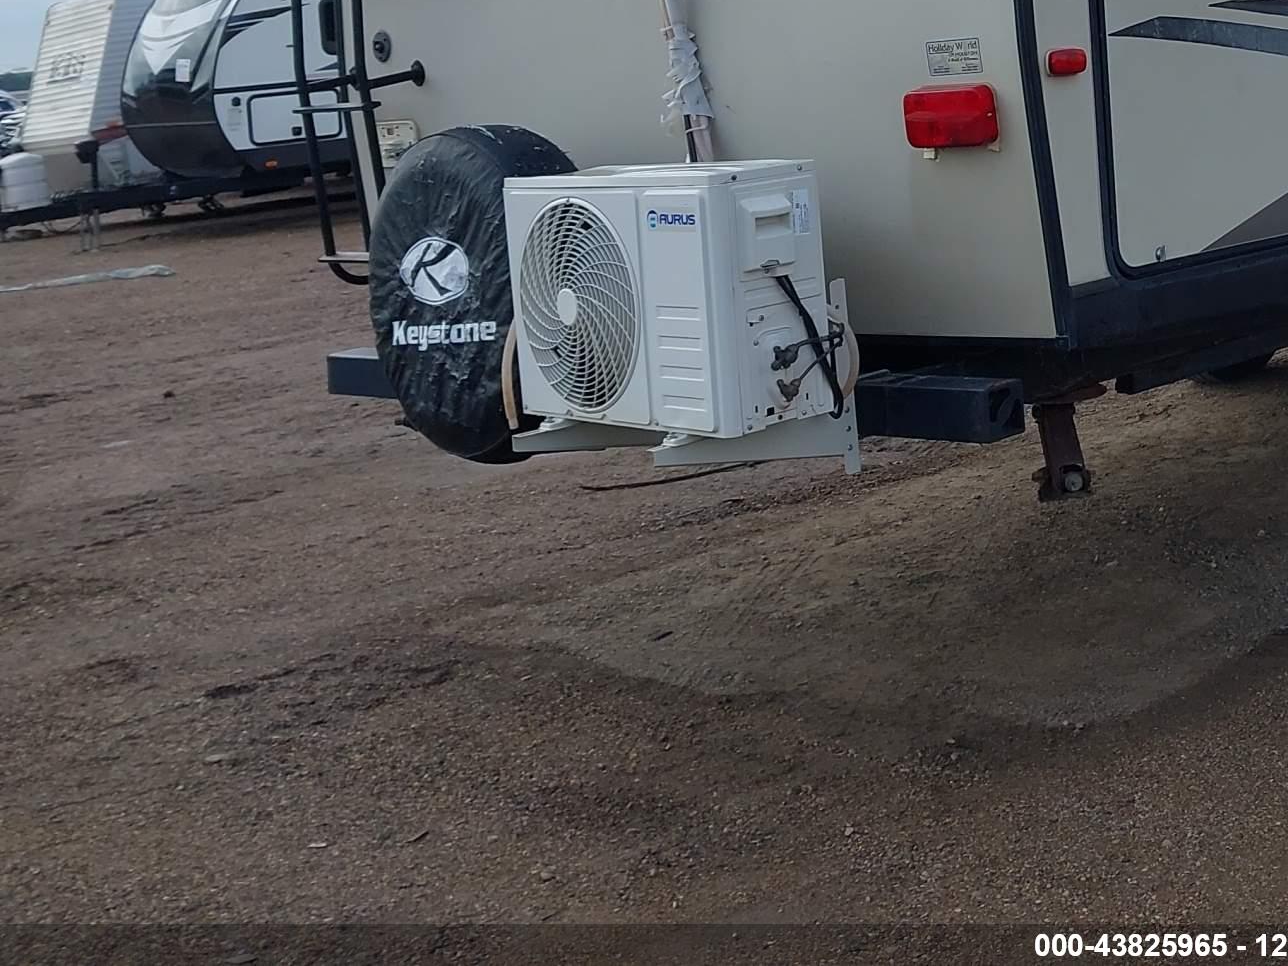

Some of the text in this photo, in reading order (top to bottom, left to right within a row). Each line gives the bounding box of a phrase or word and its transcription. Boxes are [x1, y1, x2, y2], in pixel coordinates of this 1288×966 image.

[955, 40, 978, 51] Wrld
[659, 213, 696, 226] AURUS
[392, 320, 497, 351] Keystone
